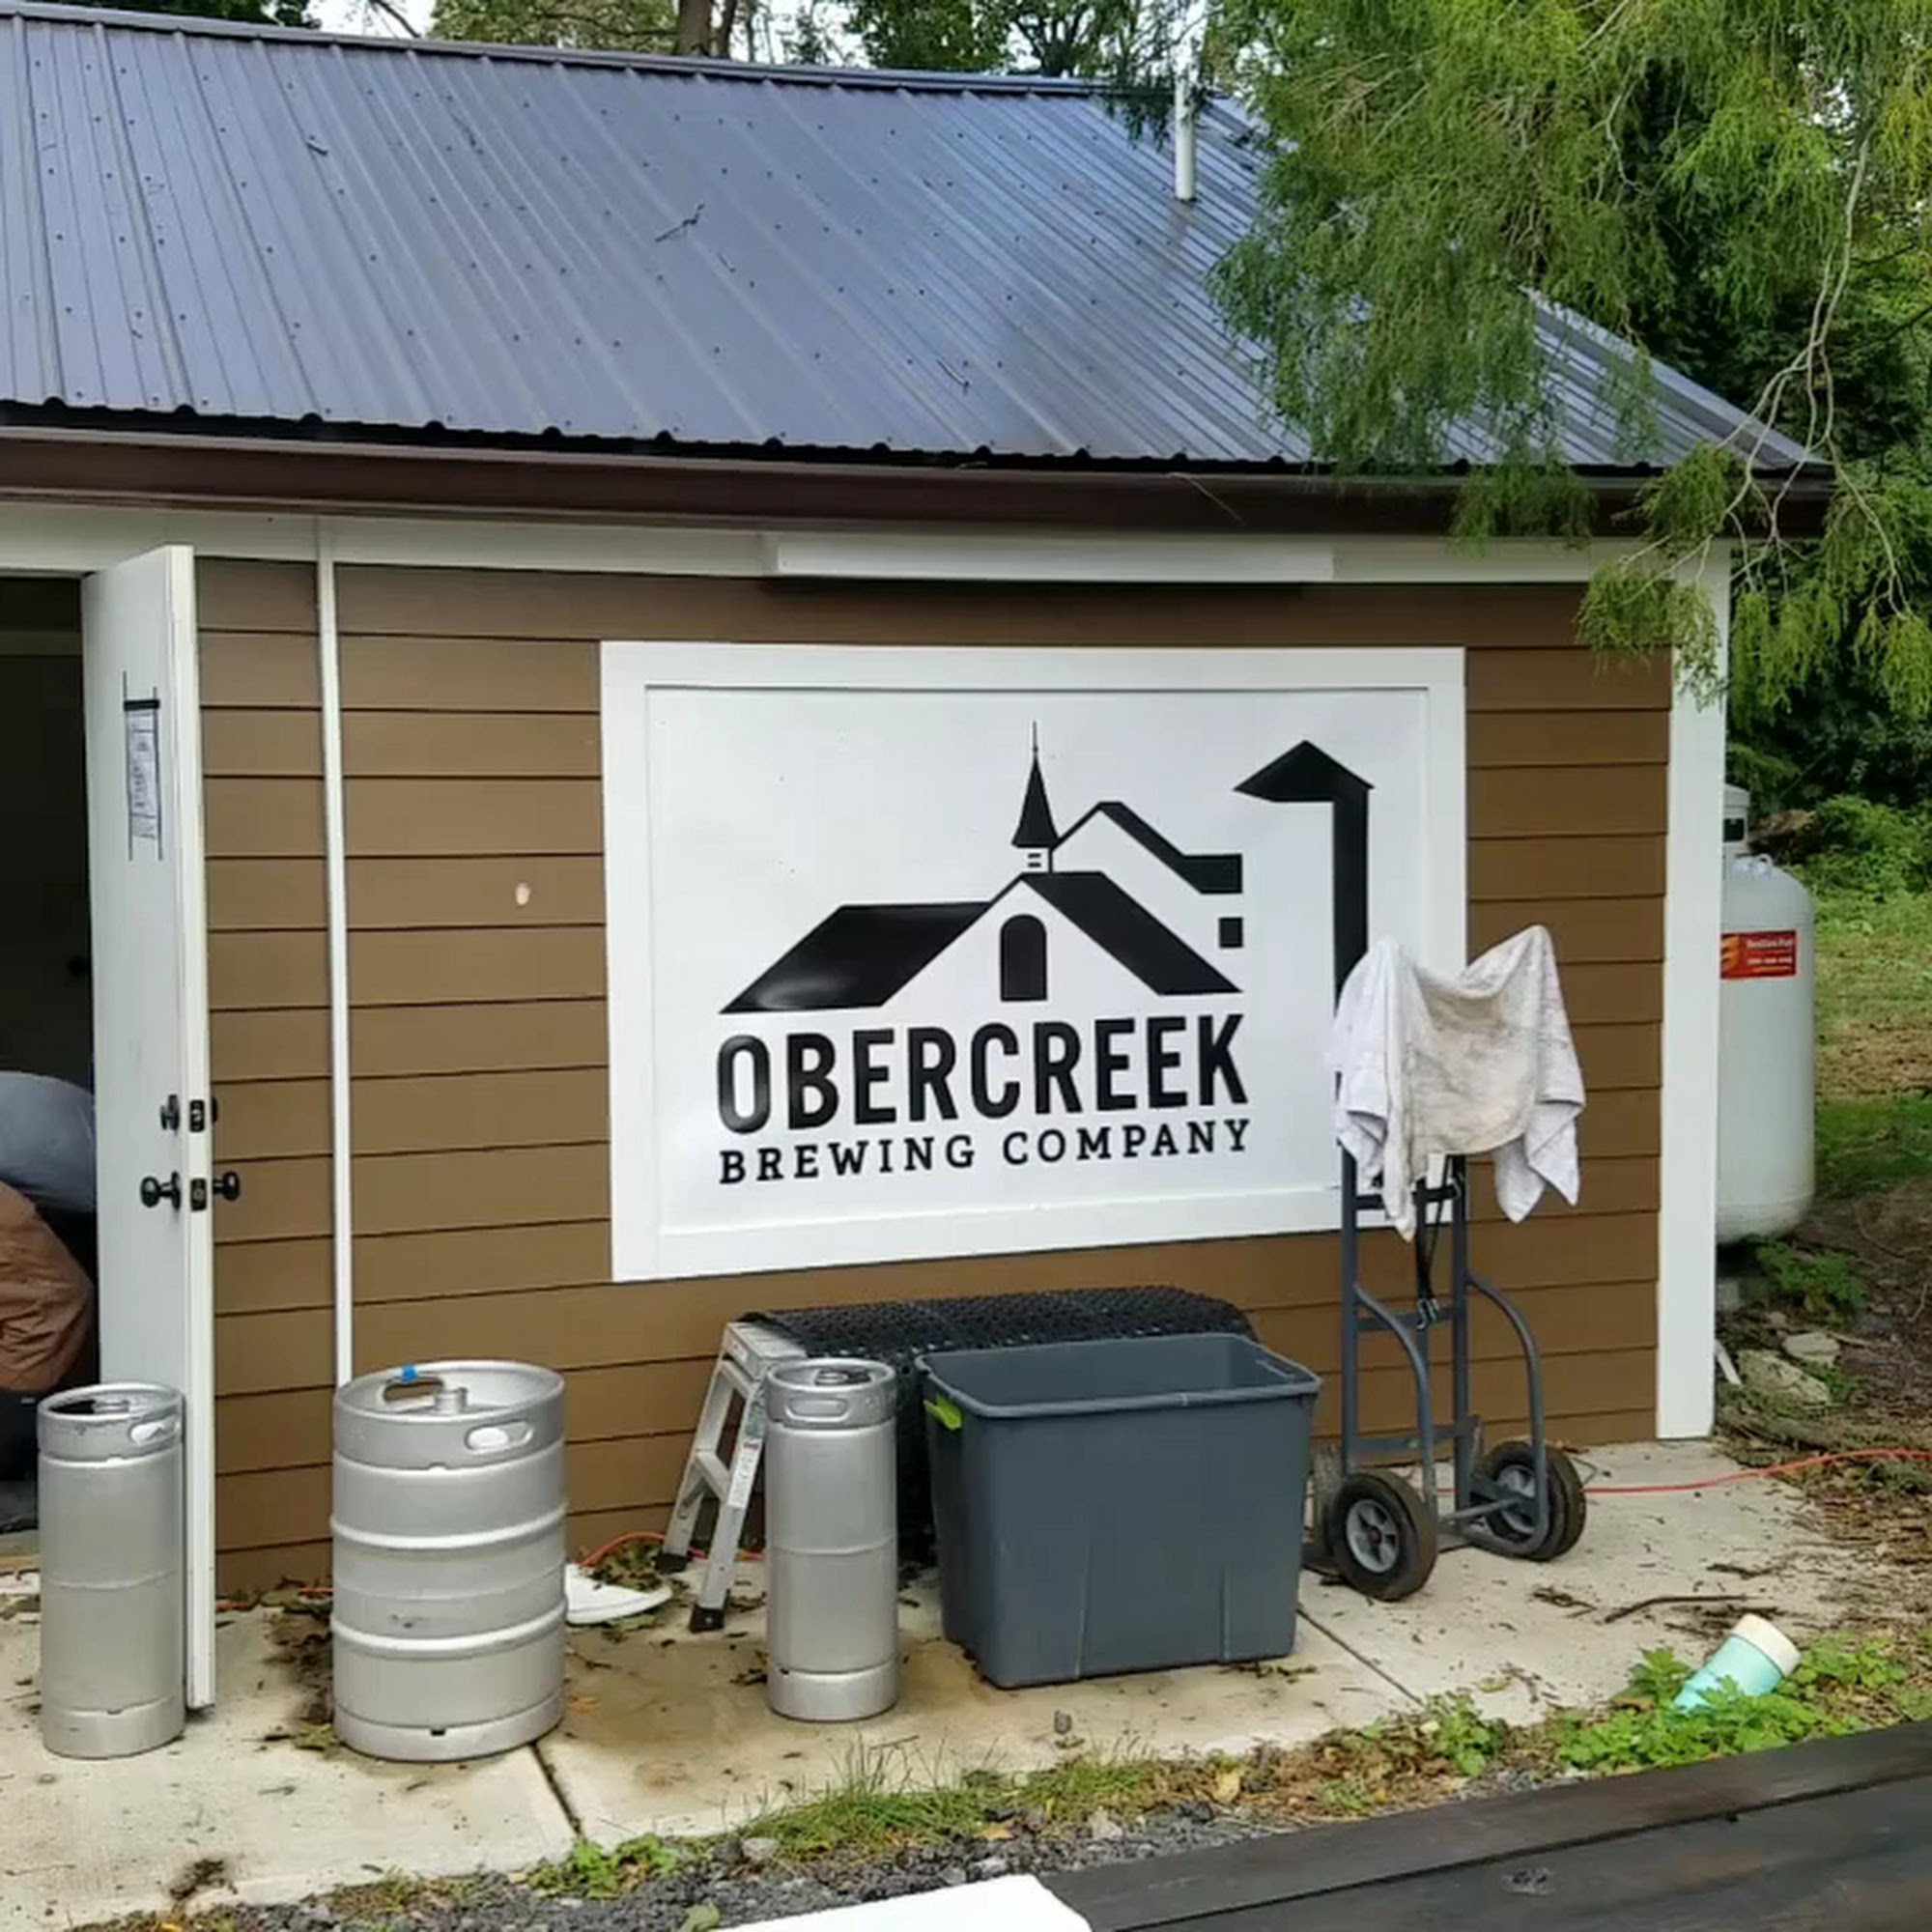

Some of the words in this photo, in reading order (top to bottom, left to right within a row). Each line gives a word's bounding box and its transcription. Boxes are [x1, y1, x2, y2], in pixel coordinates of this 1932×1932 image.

[717, 1013, 1249, 1135] OBERCREEK
[719, 1134, 975, 1184] BREWING
[1003, 1119, 1250, 1165] COMPANY
